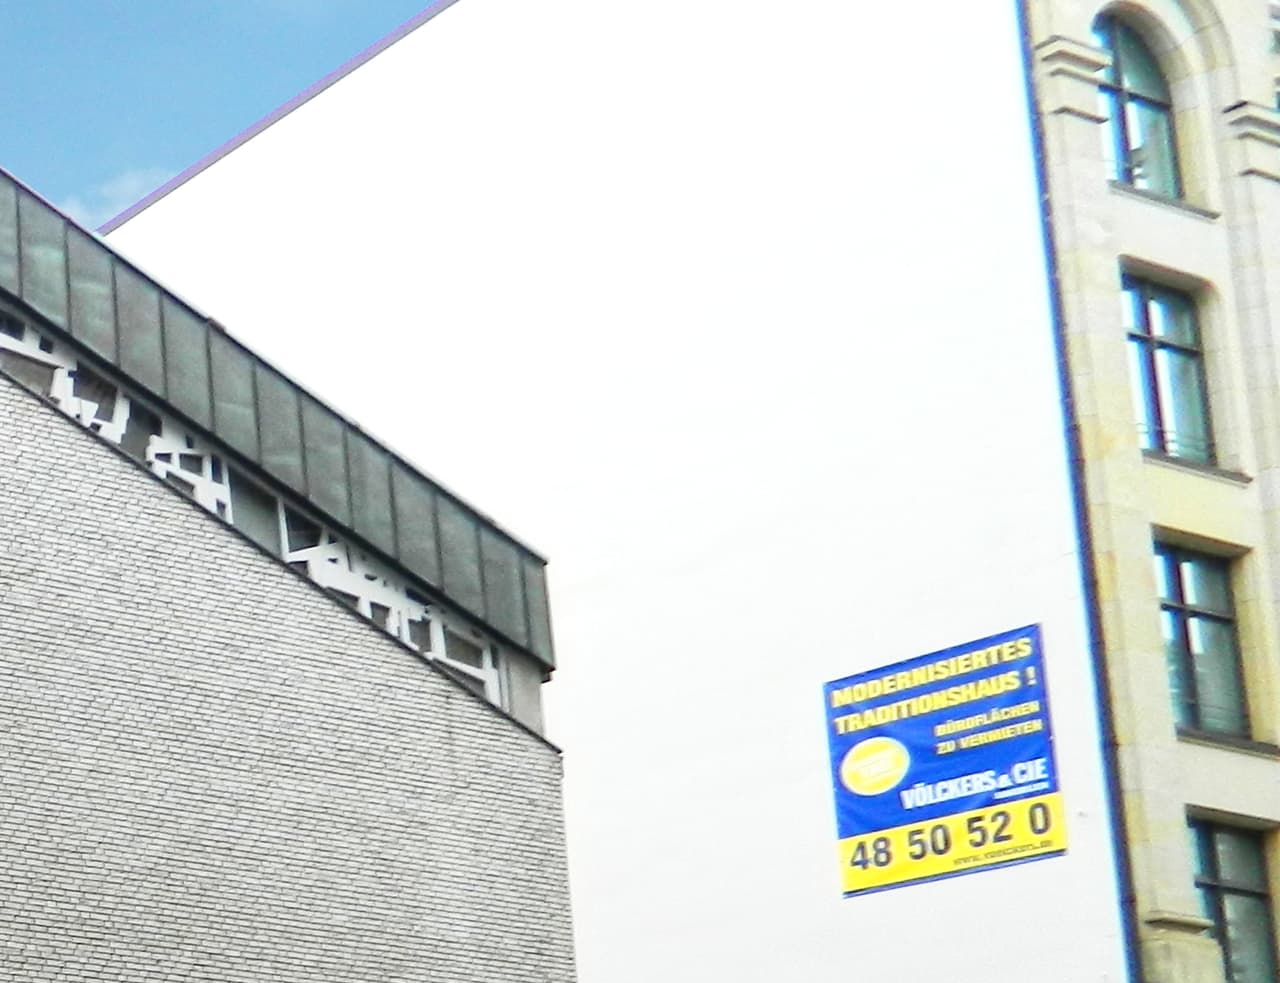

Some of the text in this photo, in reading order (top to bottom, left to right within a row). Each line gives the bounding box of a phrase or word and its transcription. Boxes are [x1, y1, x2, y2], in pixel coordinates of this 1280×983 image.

[830, 636, 1032, 708] MODERNISIERTES
[833, 670, 1021, 736] TRADITIONSHAUS
[1011, 757, 1048, 784] CIE
[850, 836, 893, 870] 48
[908, 823, 951, 860] 50
[967, 810, 1013, 847] 52
[1028, 802, 1052, 835] 0
